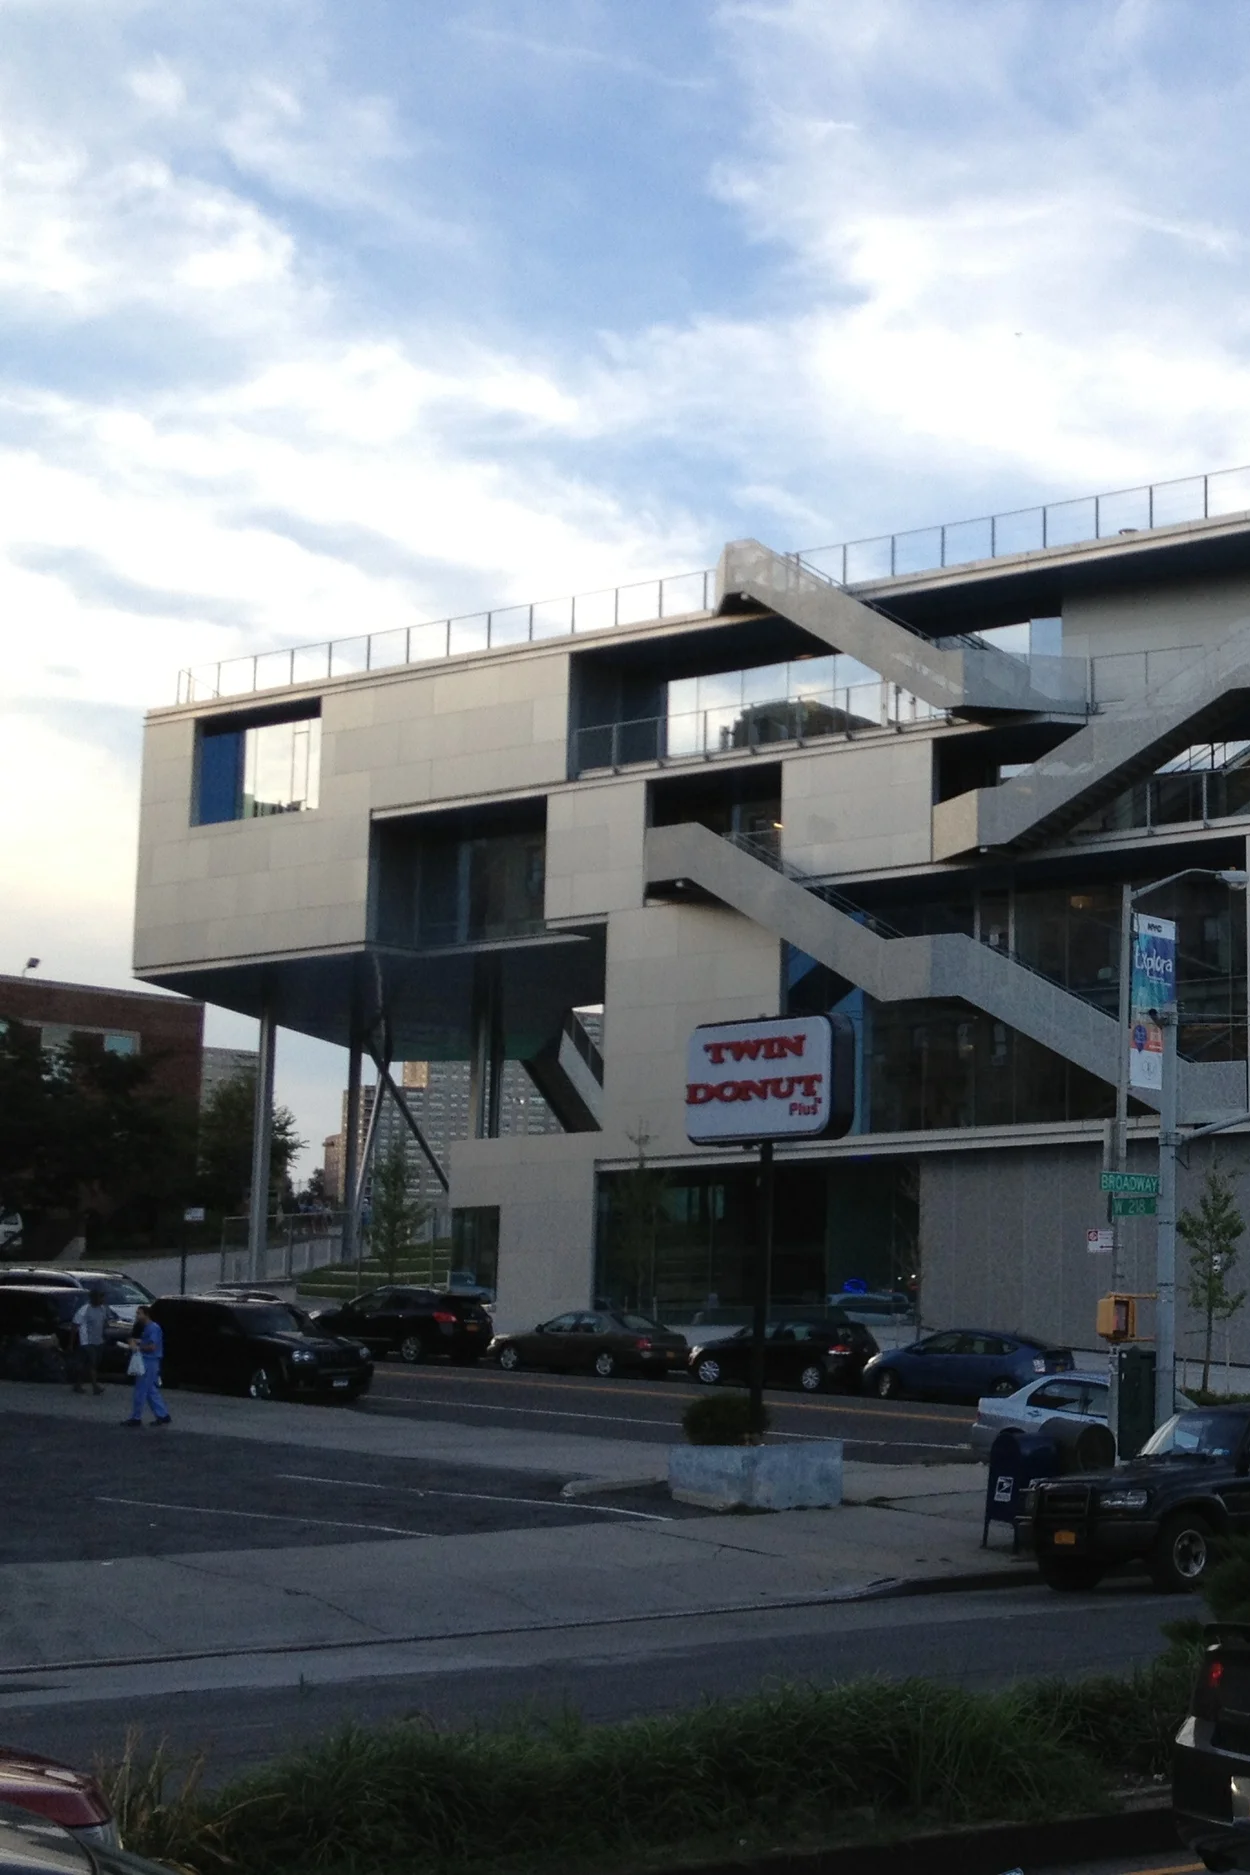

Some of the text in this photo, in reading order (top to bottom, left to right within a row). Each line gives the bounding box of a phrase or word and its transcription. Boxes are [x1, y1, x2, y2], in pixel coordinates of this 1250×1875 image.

[1135, 945, 1173, 977] Explora
[703, 1034, 806, 1064] TWIN
[685, 1074, 823, 1105] DONUT
[789, 1102, 818, 1116] Plus
[1101, 1174, 1157, 1192] BROADWAY
[1114, 1200, 1123, 1213] W
[1128, 1199, 1146, 1213] 218
